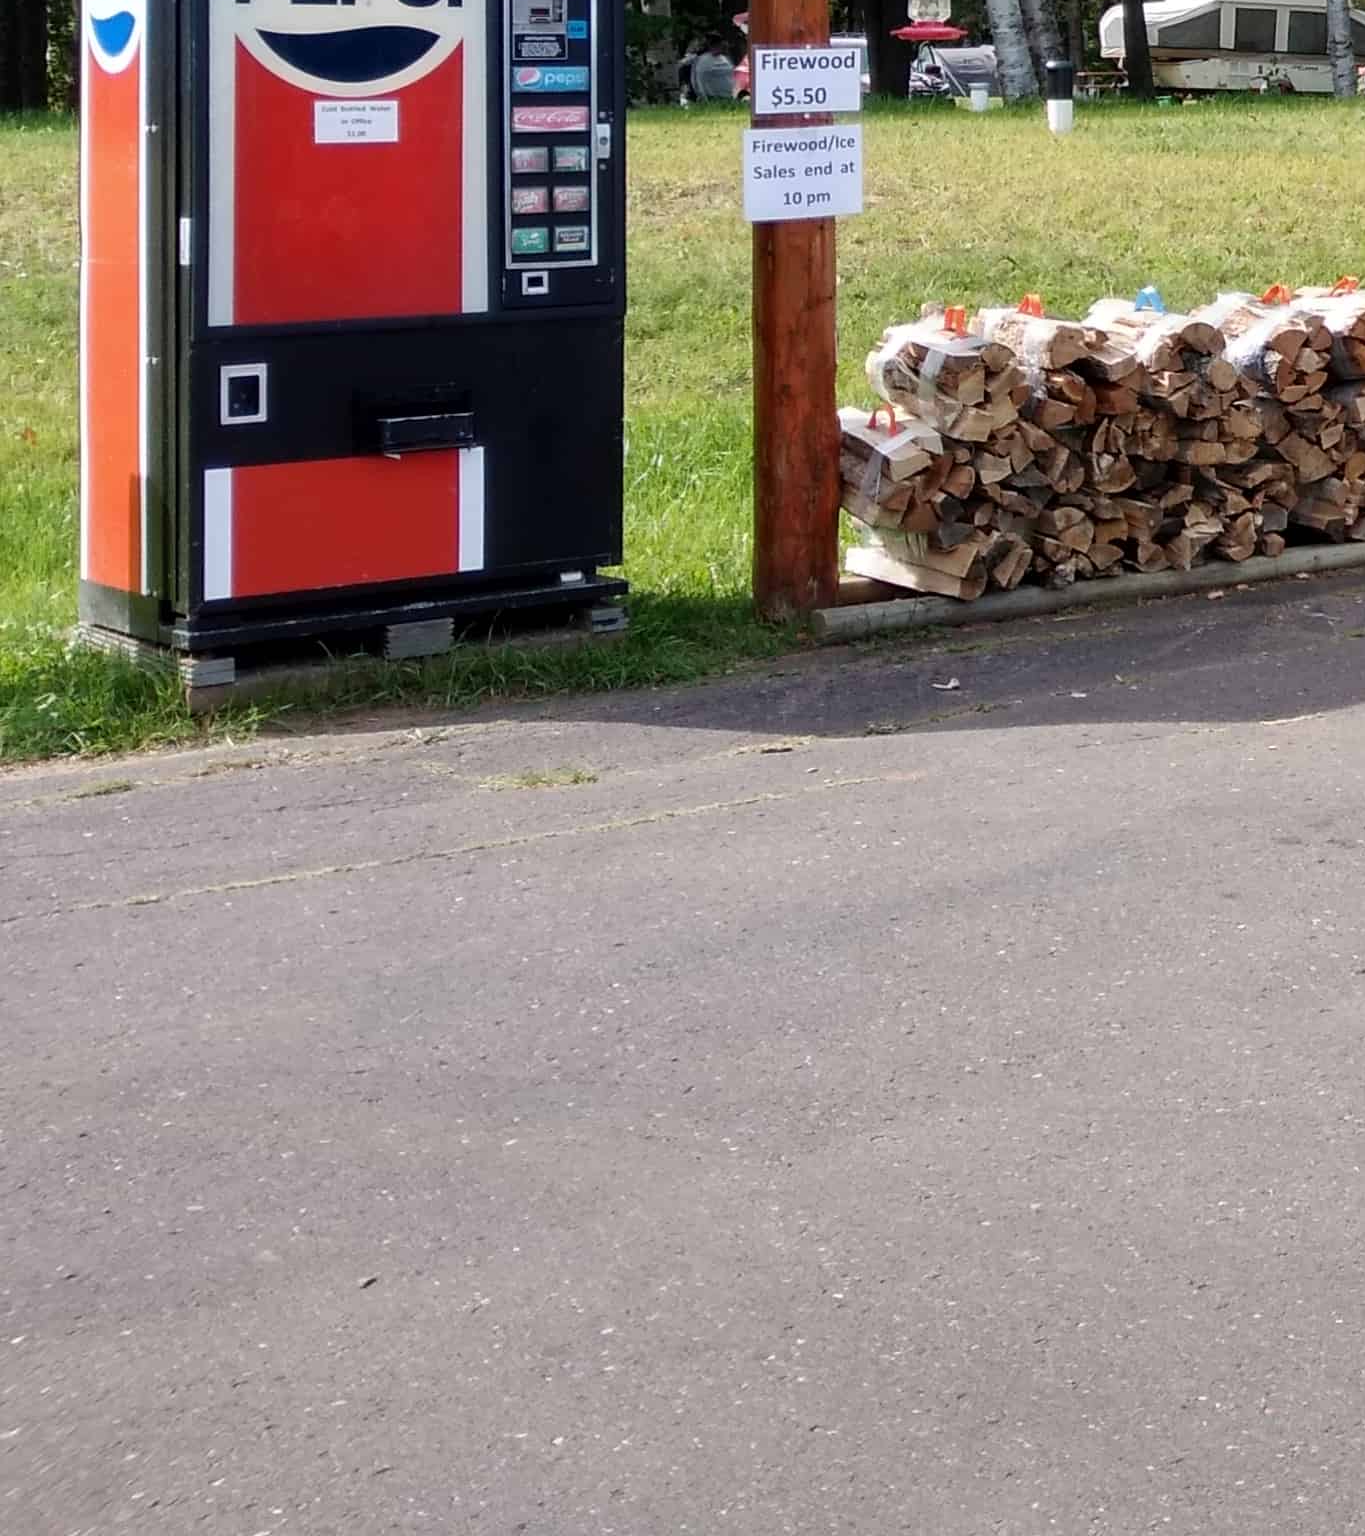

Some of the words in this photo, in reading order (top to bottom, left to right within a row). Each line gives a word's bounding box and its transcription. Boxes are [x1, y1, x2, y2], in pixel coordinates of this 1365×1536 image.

[761, 51, 856, 71] Firewood
[771, 86, 827, 107] $5.50
[752, 135, 856, 153] Firewood/Ice
[753, 165, 795, 179] Sales
[804, 161, 832, 177] end
[840, 161, 854, 174] at
[784, 192, 802, 205] 10
[806, 192, 831, 207] pm
